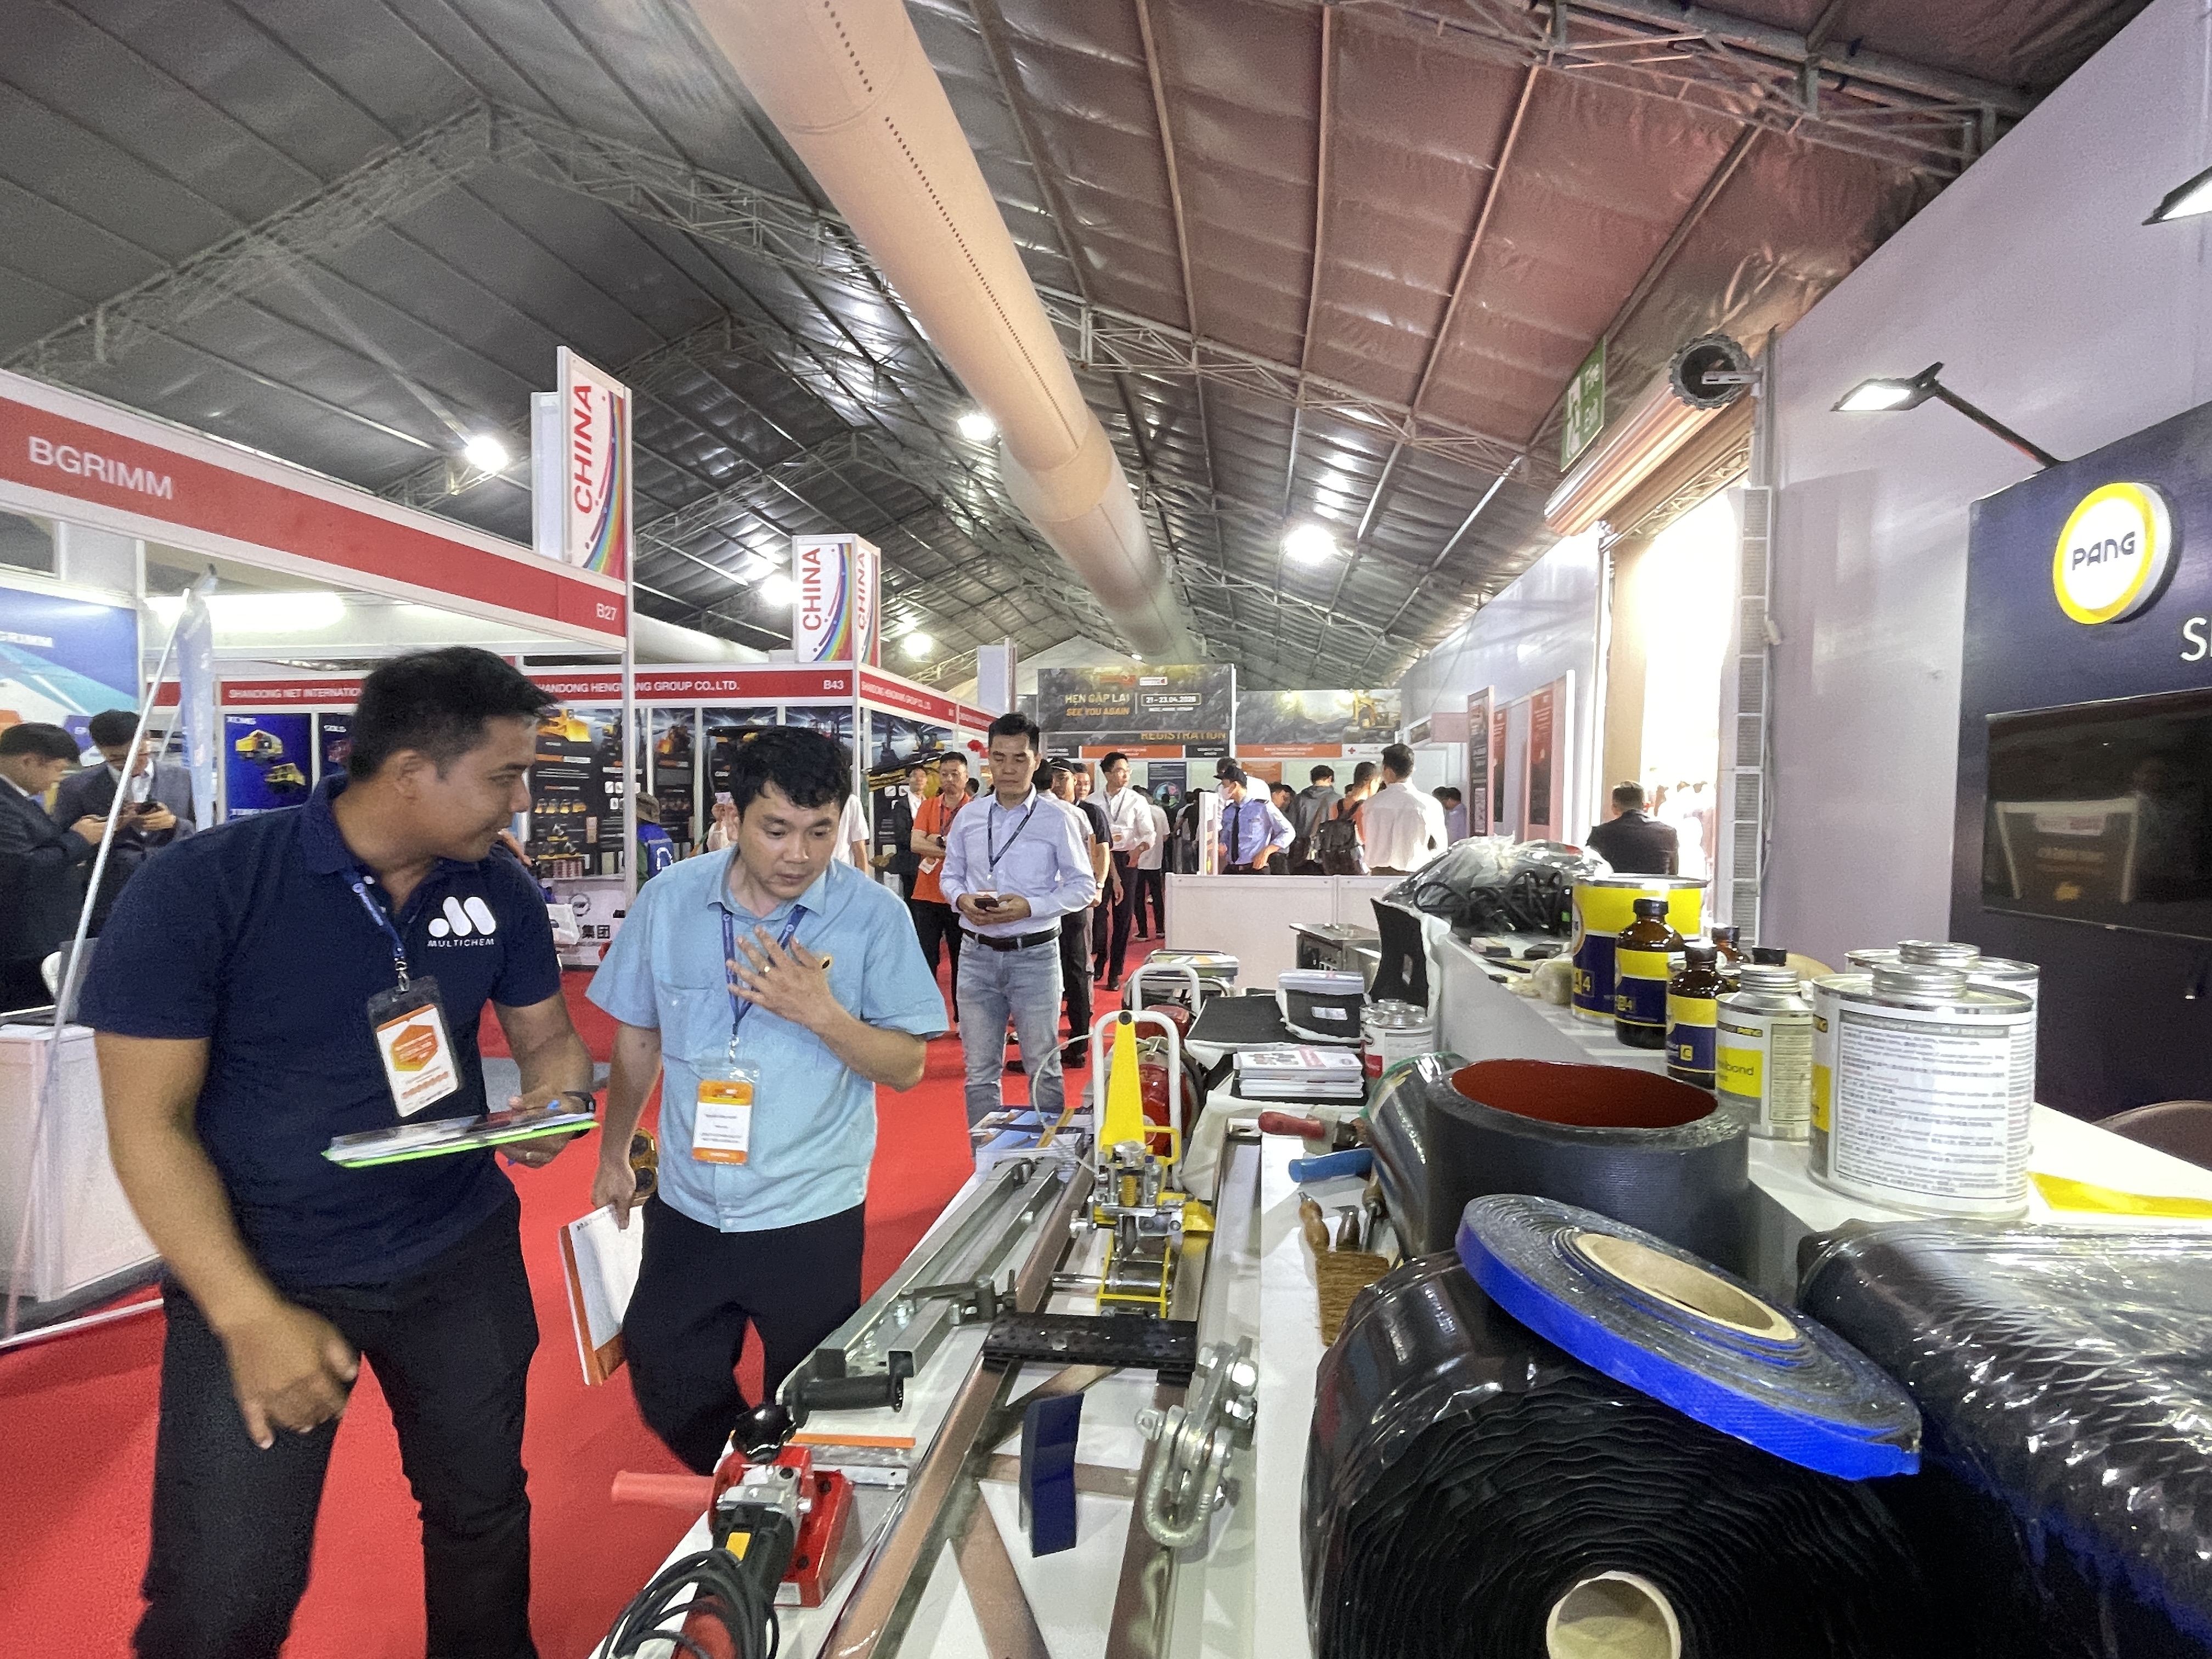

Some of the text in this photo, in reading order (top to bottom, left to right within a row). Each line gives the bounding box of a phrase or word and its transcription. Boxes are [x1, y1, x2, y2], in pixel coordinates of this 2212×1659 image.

[573, 385, 592, 514] CHINA
[29, 436, 172, 500] BGRIMM
[2072, 531, 2136, 571] PANG
[802, 548, 821, 630] CHINA
[857, 552, 866, 630] CHINA
[596, 603, 618, 622] B27
[2180, 617, 2212, 661] S
[535, 684, 589, 693] HANDONG
[654, 681, 692, 691] GROUP
[823, 679, 844, 691] B43
[1085, 707, 1102, 716] YOU
[1103, 707, 1131, 715] AGAIN
[1140, 732, 1226, 740] REGISTRATION
[577, 924, 611, 939] 集团
[427, 938, 494, 947] MULTICHEM
[1682, 1048, 1691, 1059] C
